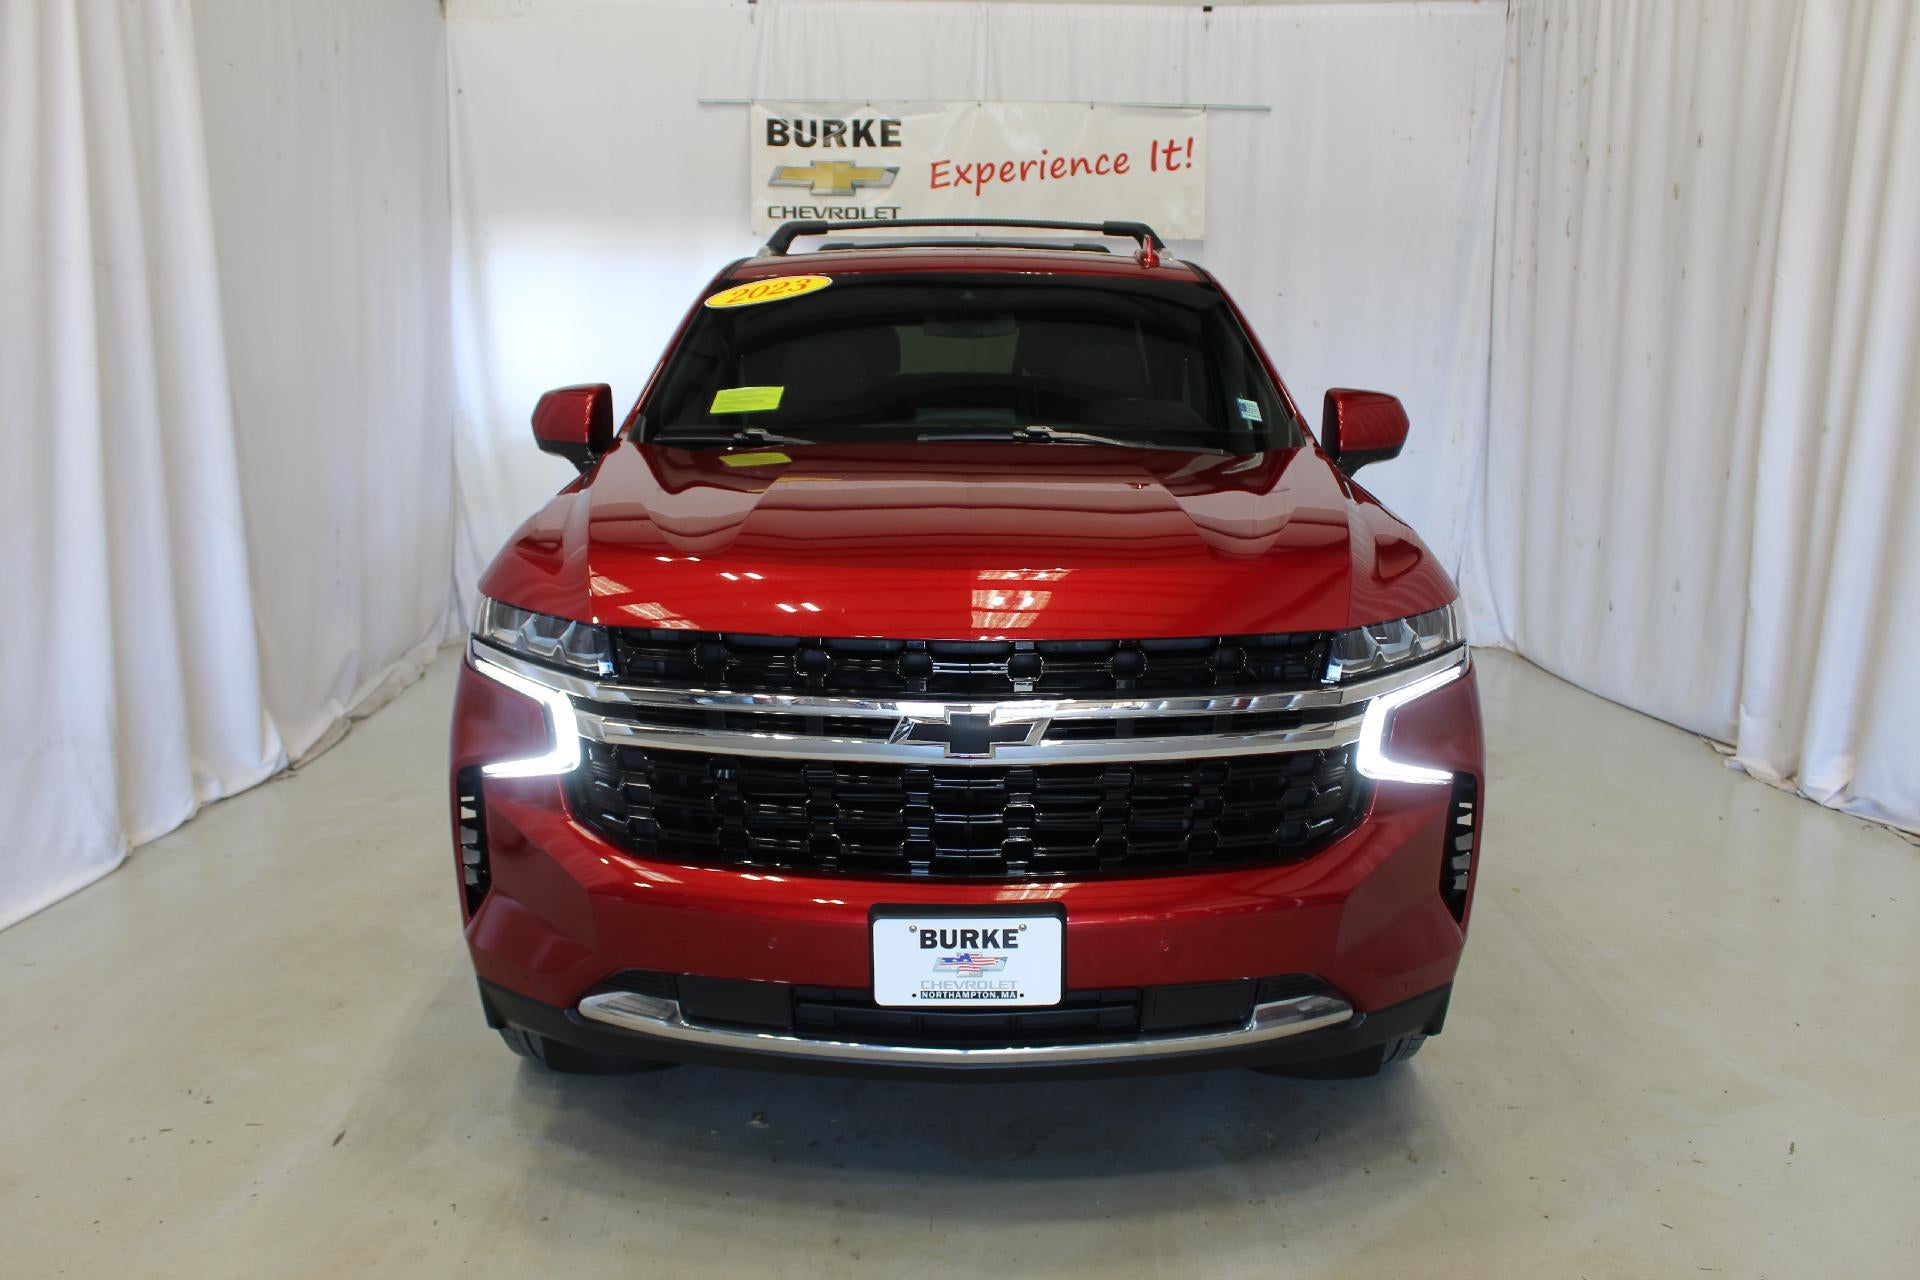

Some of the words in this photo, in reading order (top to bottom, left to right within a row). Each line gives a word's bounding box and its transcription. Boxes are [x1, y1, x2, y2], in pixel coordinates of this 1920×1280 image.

[766, 118, 902, 148] BURKE
[930, 149, 1130, 196] Experience
[1150, 136, 1194, 172] It!
[767, 205, 902, 220] CHEVROLET
[726, 278, 812, 304] 2023
[919, 928, 1019, 949] BURKE
[920, 980, 1018, 990] CHEVROLET
